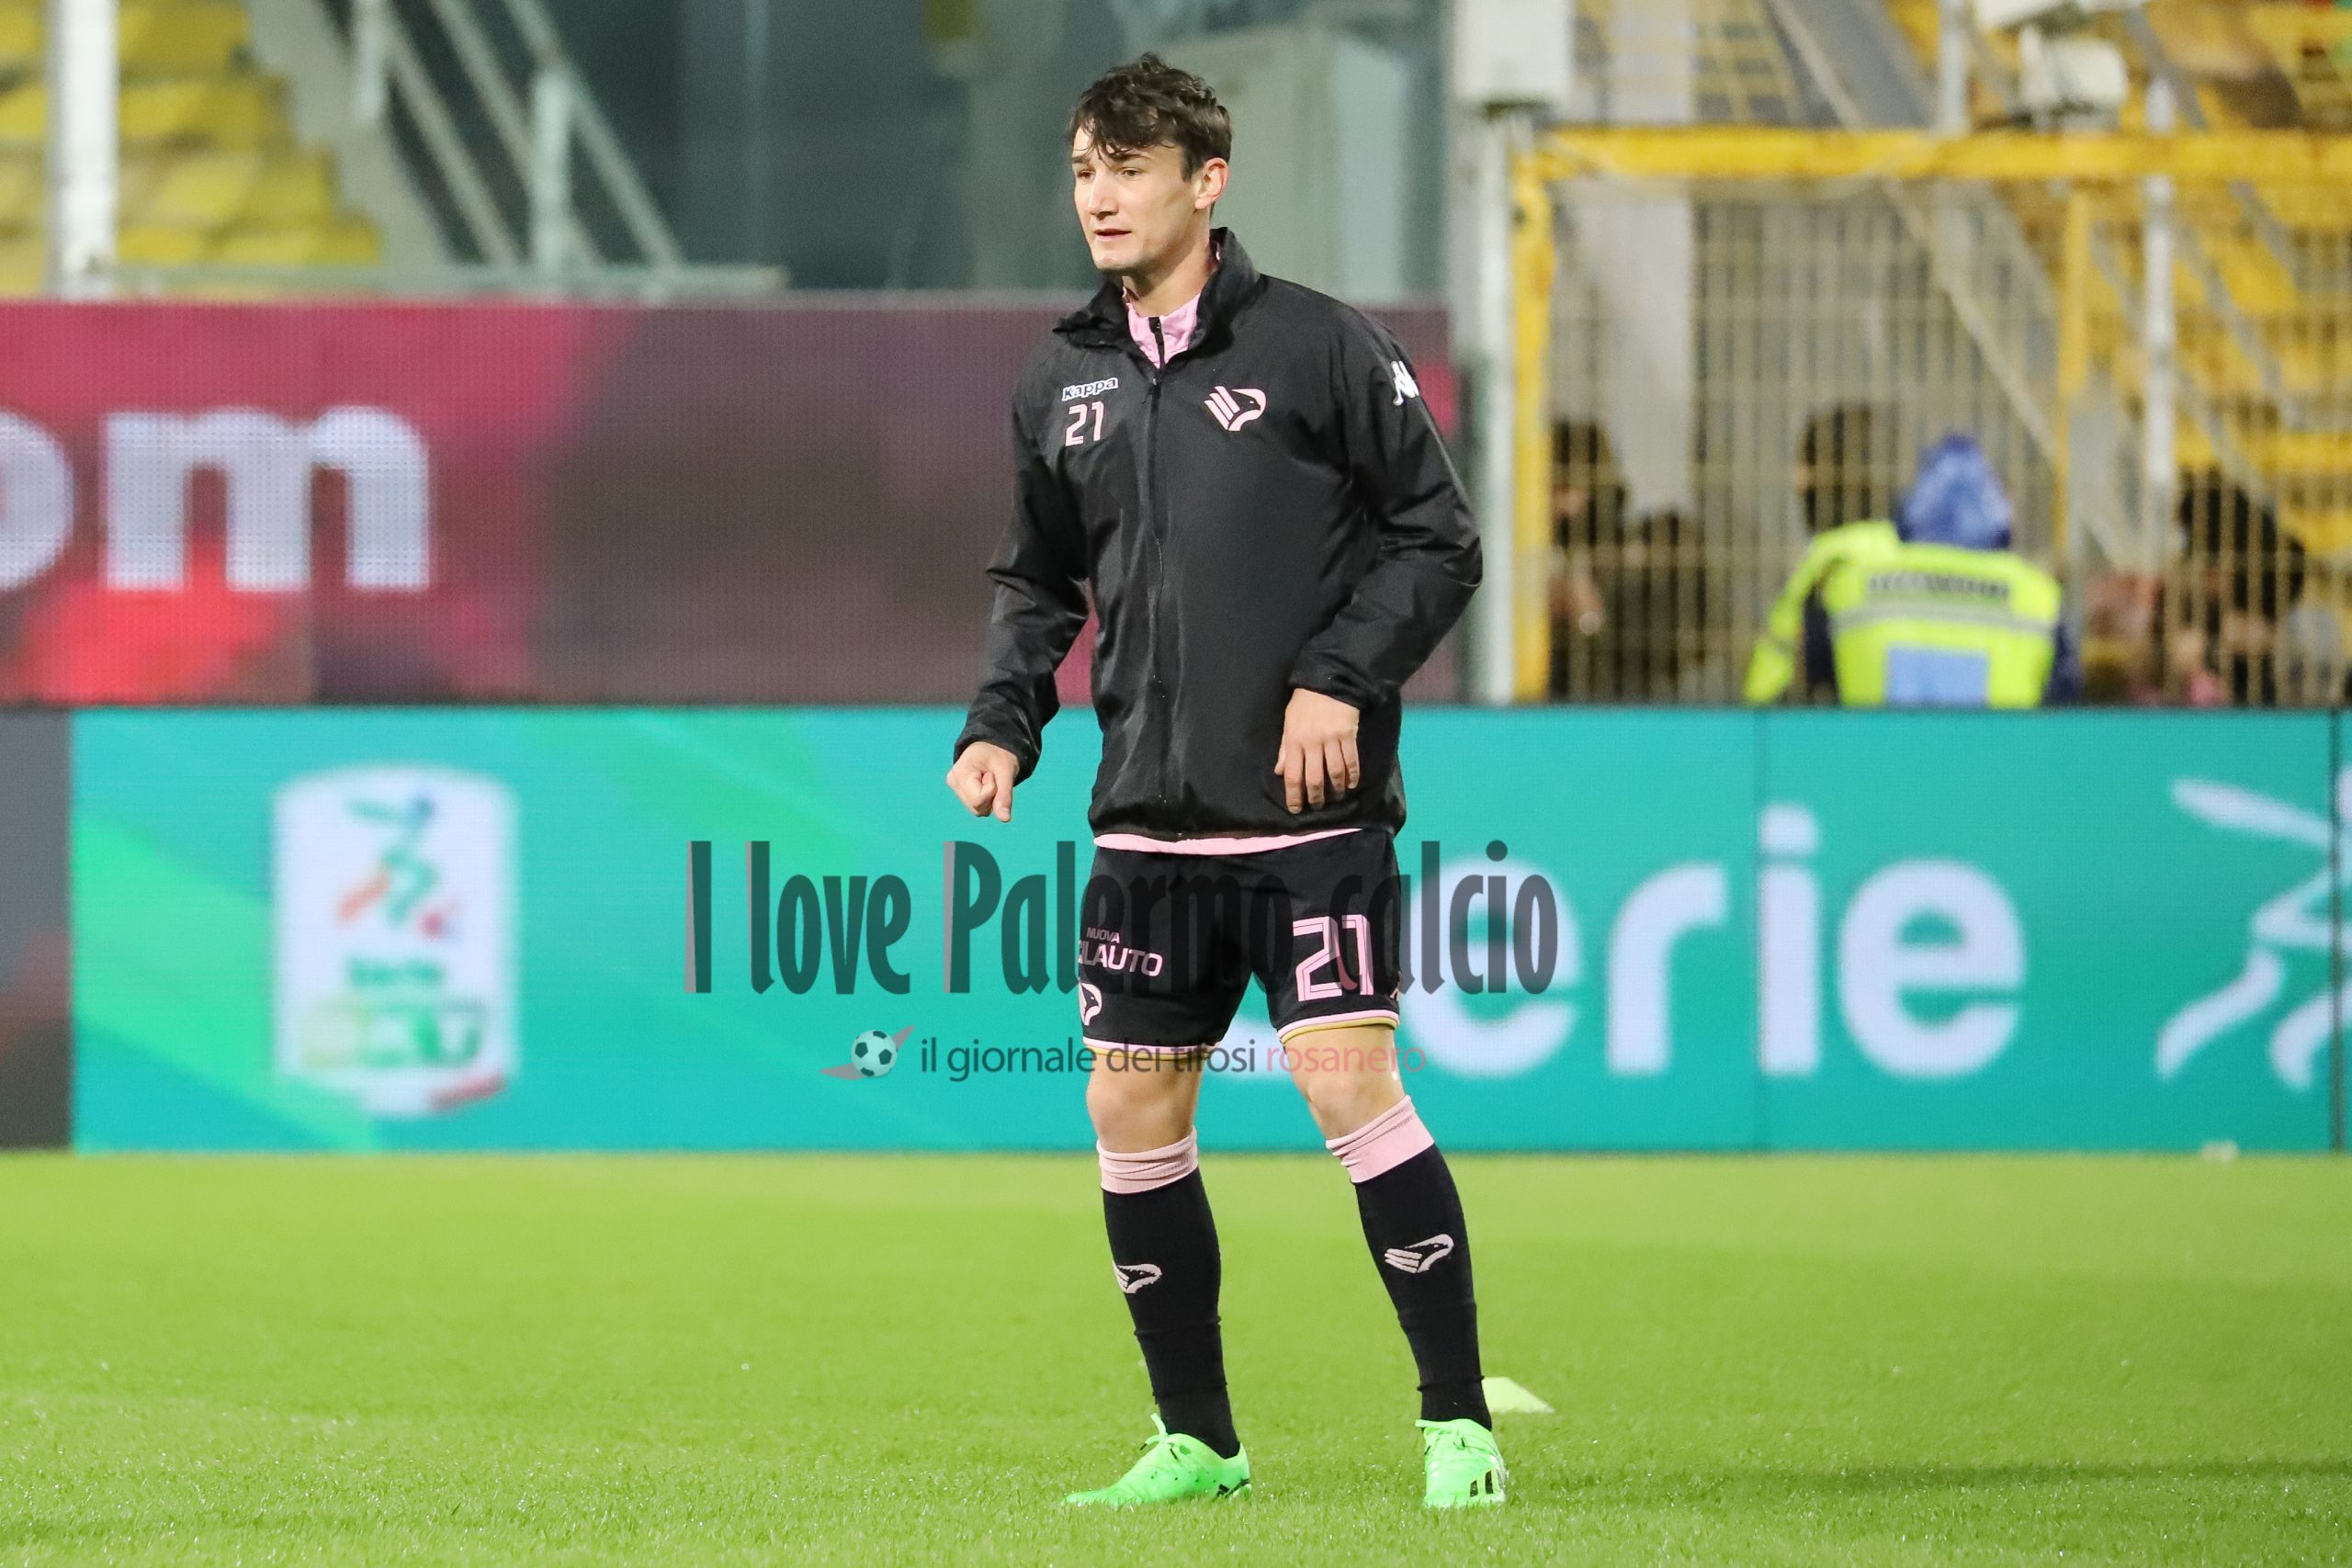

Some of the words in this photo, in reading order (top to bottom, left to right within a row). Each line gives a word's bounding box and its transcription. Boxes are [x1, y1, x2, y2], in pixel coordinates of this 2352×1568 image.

[1061, 377, 1119, 401] Kappa
[1065, 400, 1104, 446] 21
[1086, 927, 1120, 943] NUOVA
[1213, 802, 2026, 1082] erie
[1293, 914, 1374, 1002] 21
